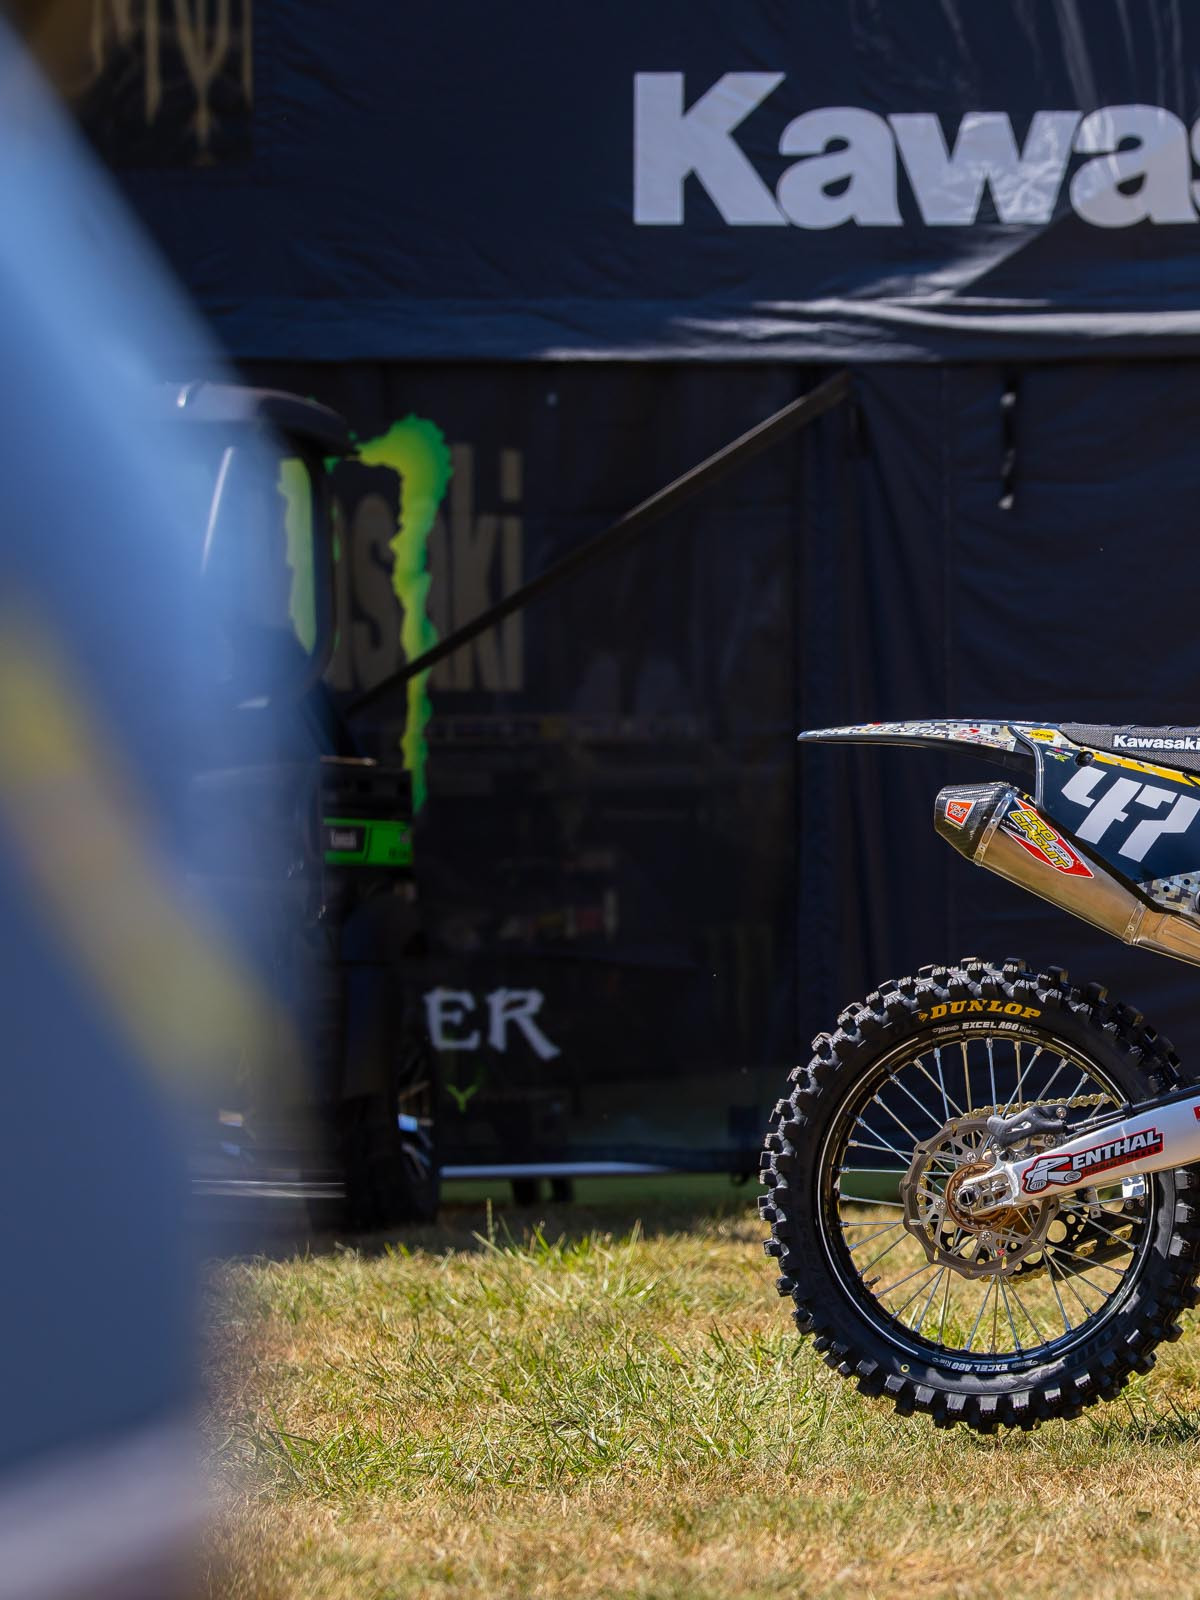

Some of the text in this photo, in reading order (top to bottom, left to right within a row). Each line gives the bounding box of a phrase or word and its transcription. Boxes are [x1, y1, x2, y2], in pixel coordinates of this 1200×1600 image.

[1022, 810, 1058, 842] PRO
[1010, 811, 1070, 869] CIRCUIT
[930, 999, 1041, 1019] DUNLOP
[962, 1021, 997, 1030] EXCEL
[998, 1021, 1019, 1031] A60
[974, 1363, 1008, 1372] EXCEL
